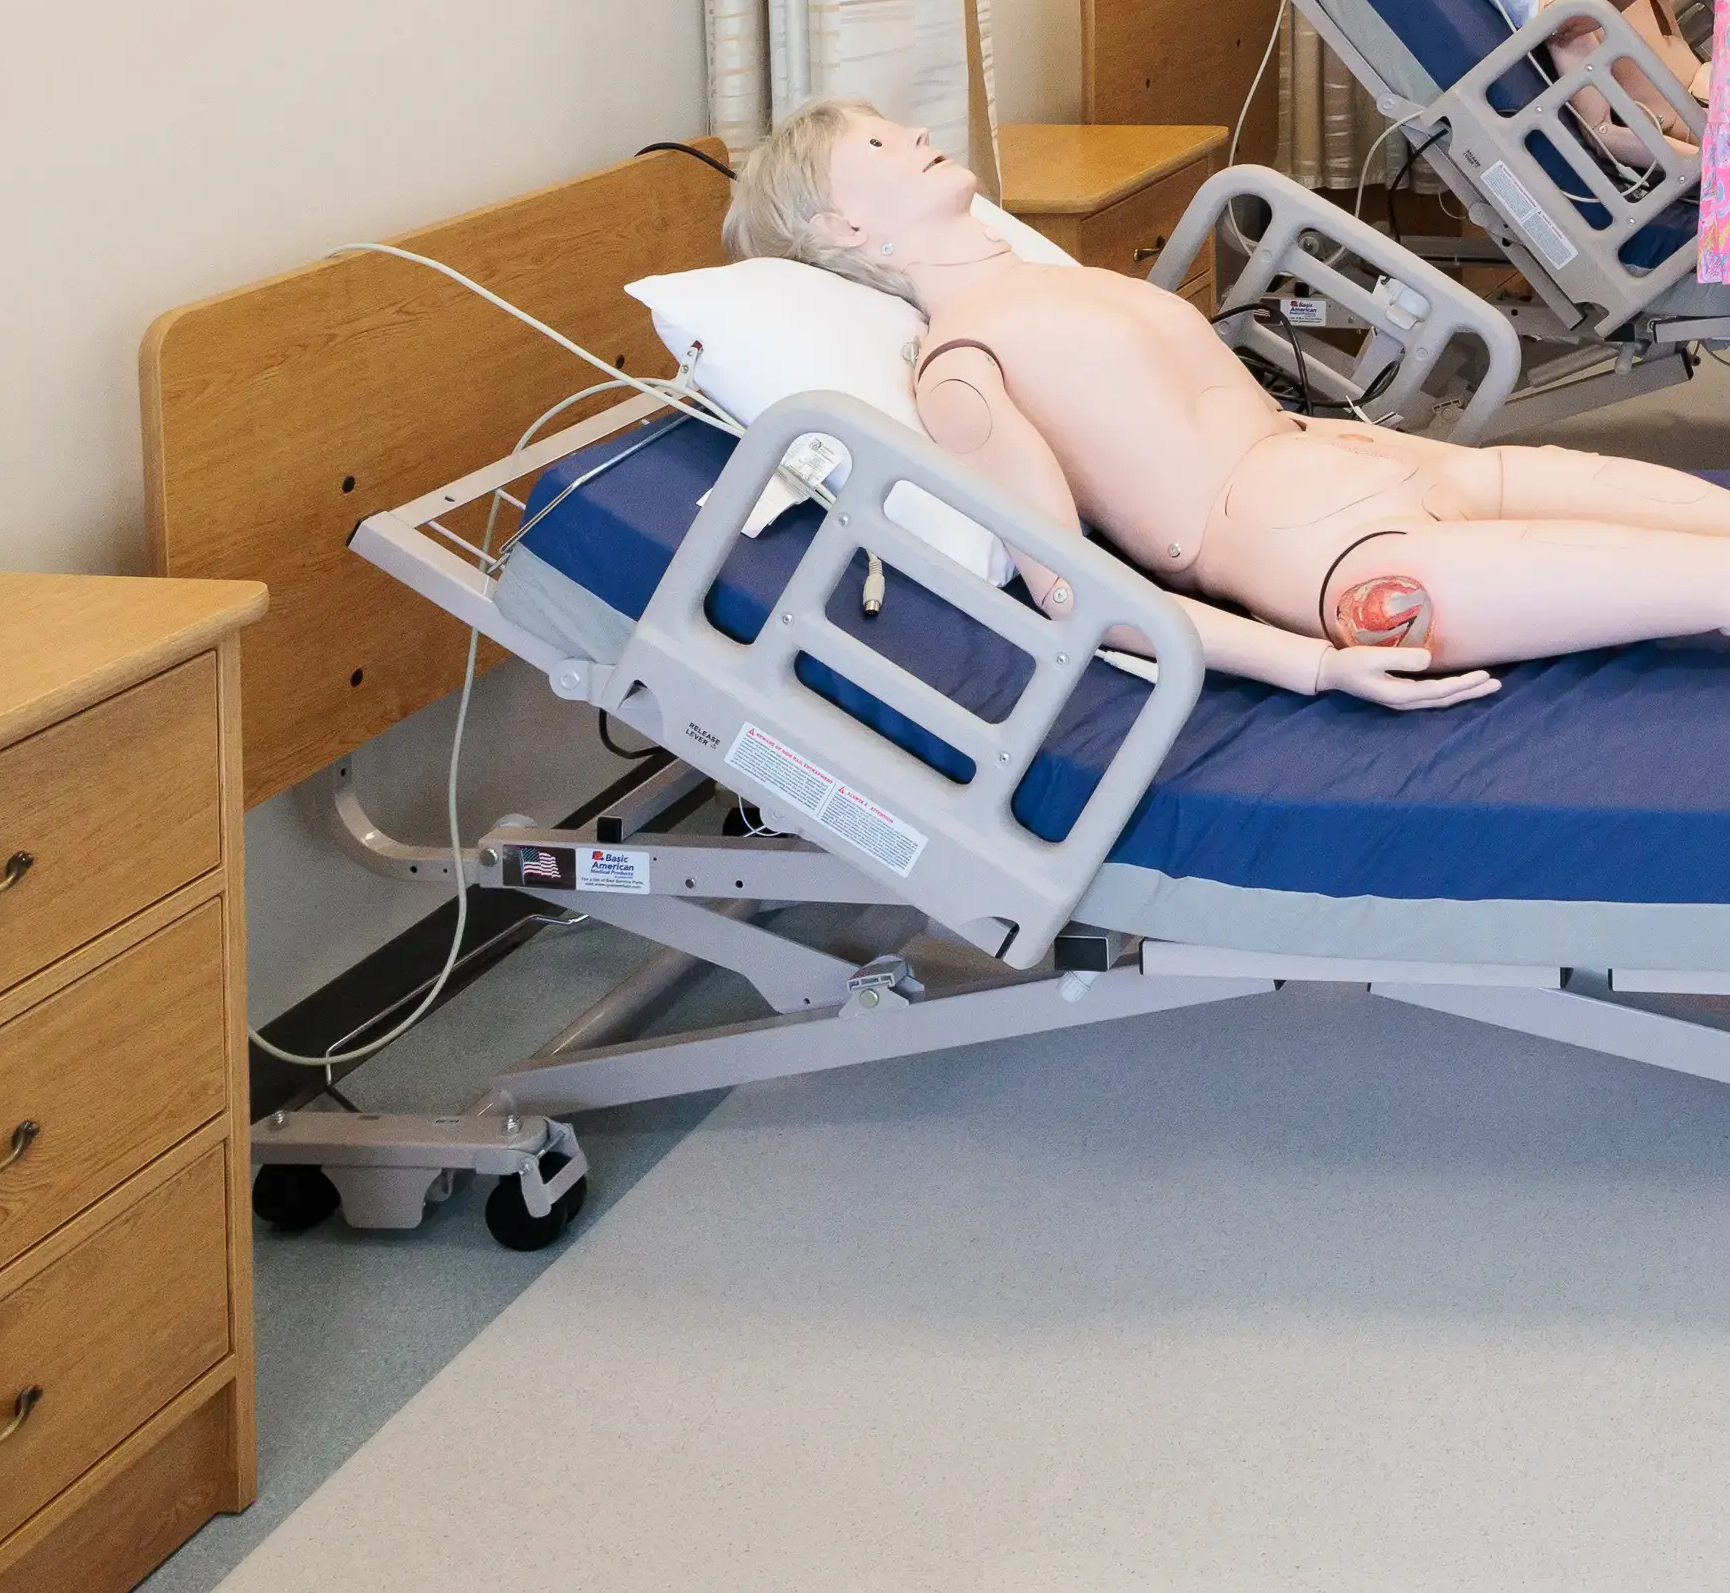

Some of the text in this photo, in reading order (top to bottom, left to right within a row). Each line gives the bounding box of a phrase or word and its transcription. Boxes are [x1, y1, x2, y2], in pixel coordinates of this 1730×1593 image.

[686, 728, 708, 745] LEVER
[689, 723, 720, 745] RELEASE
[606, 854, 628, 863] Basic
[592, 861, 634, 871] American
